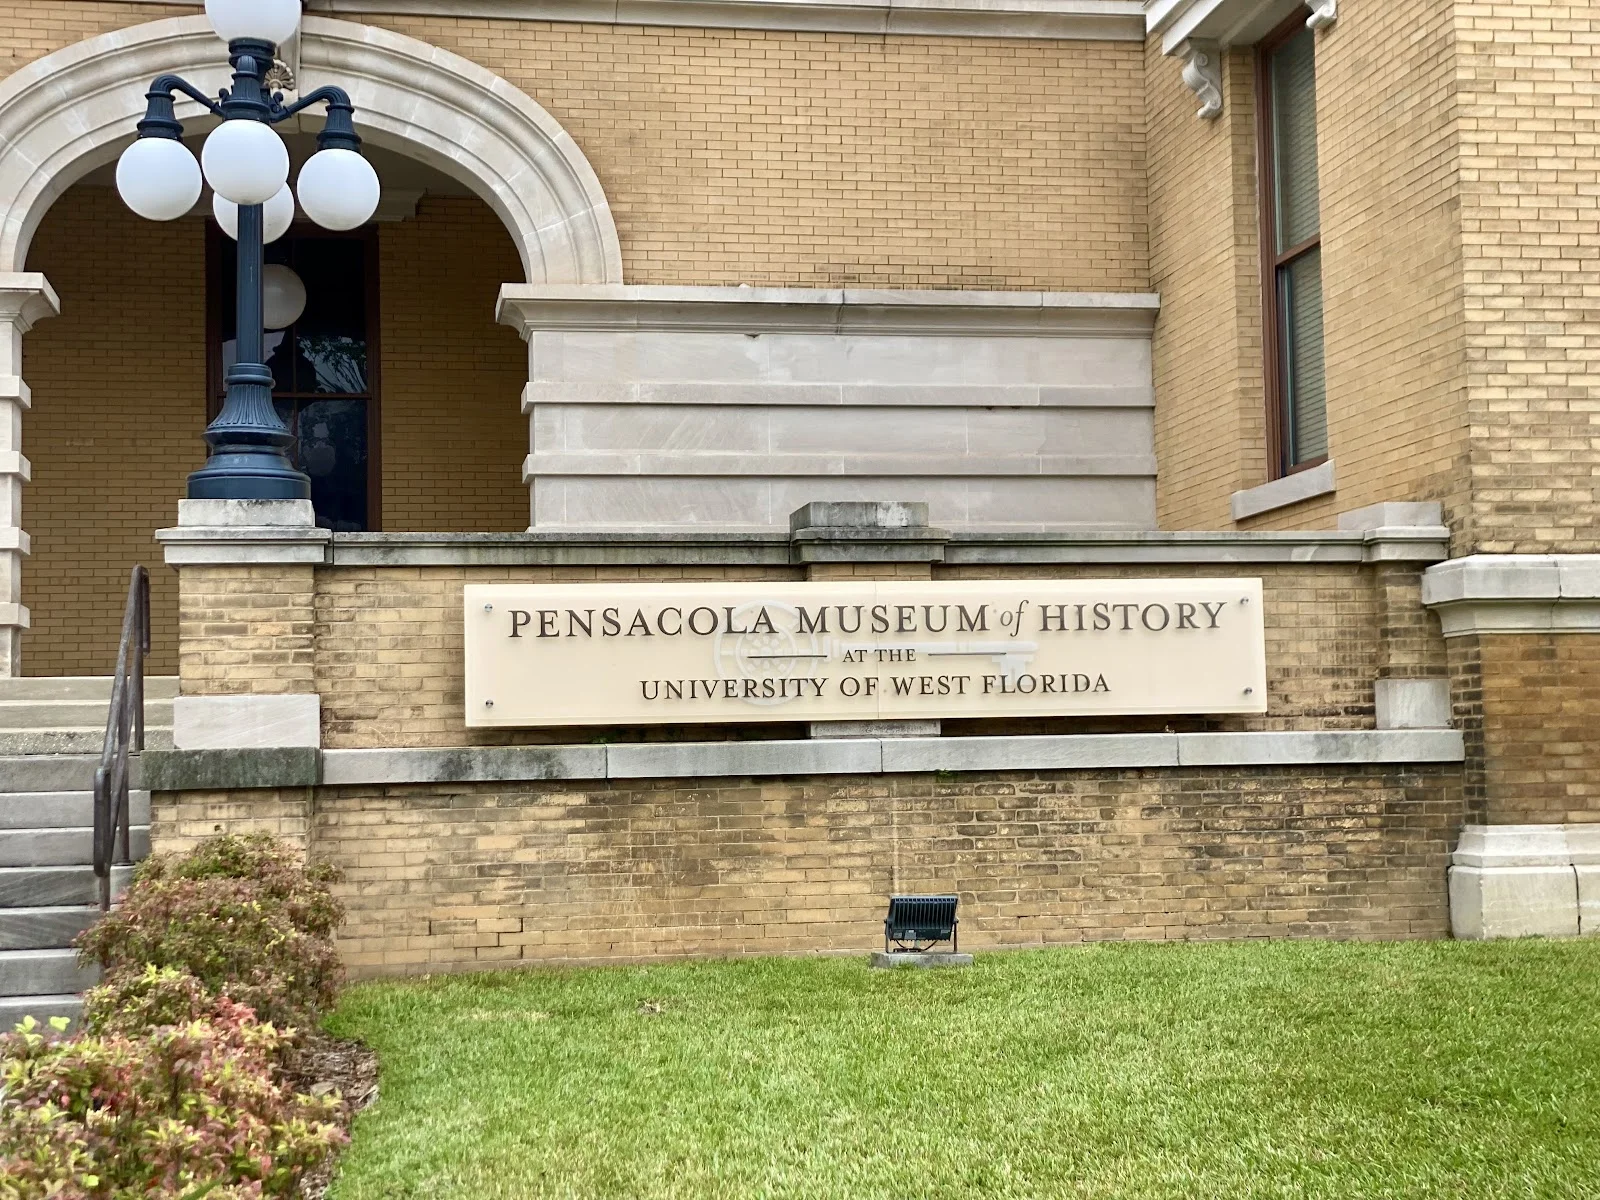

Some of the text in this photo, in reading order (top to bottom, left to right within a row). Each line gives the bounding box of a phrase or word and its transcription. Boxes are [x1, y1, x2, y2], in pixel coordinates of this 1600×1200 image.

[508, 600, 1225, 638] PENSACOLA MUSEUM of HISTORY
[842, 648, 917, 663] AT THE
[640, 673, 1110, 700] UNIVERSITY OF WEST FLORIDA
